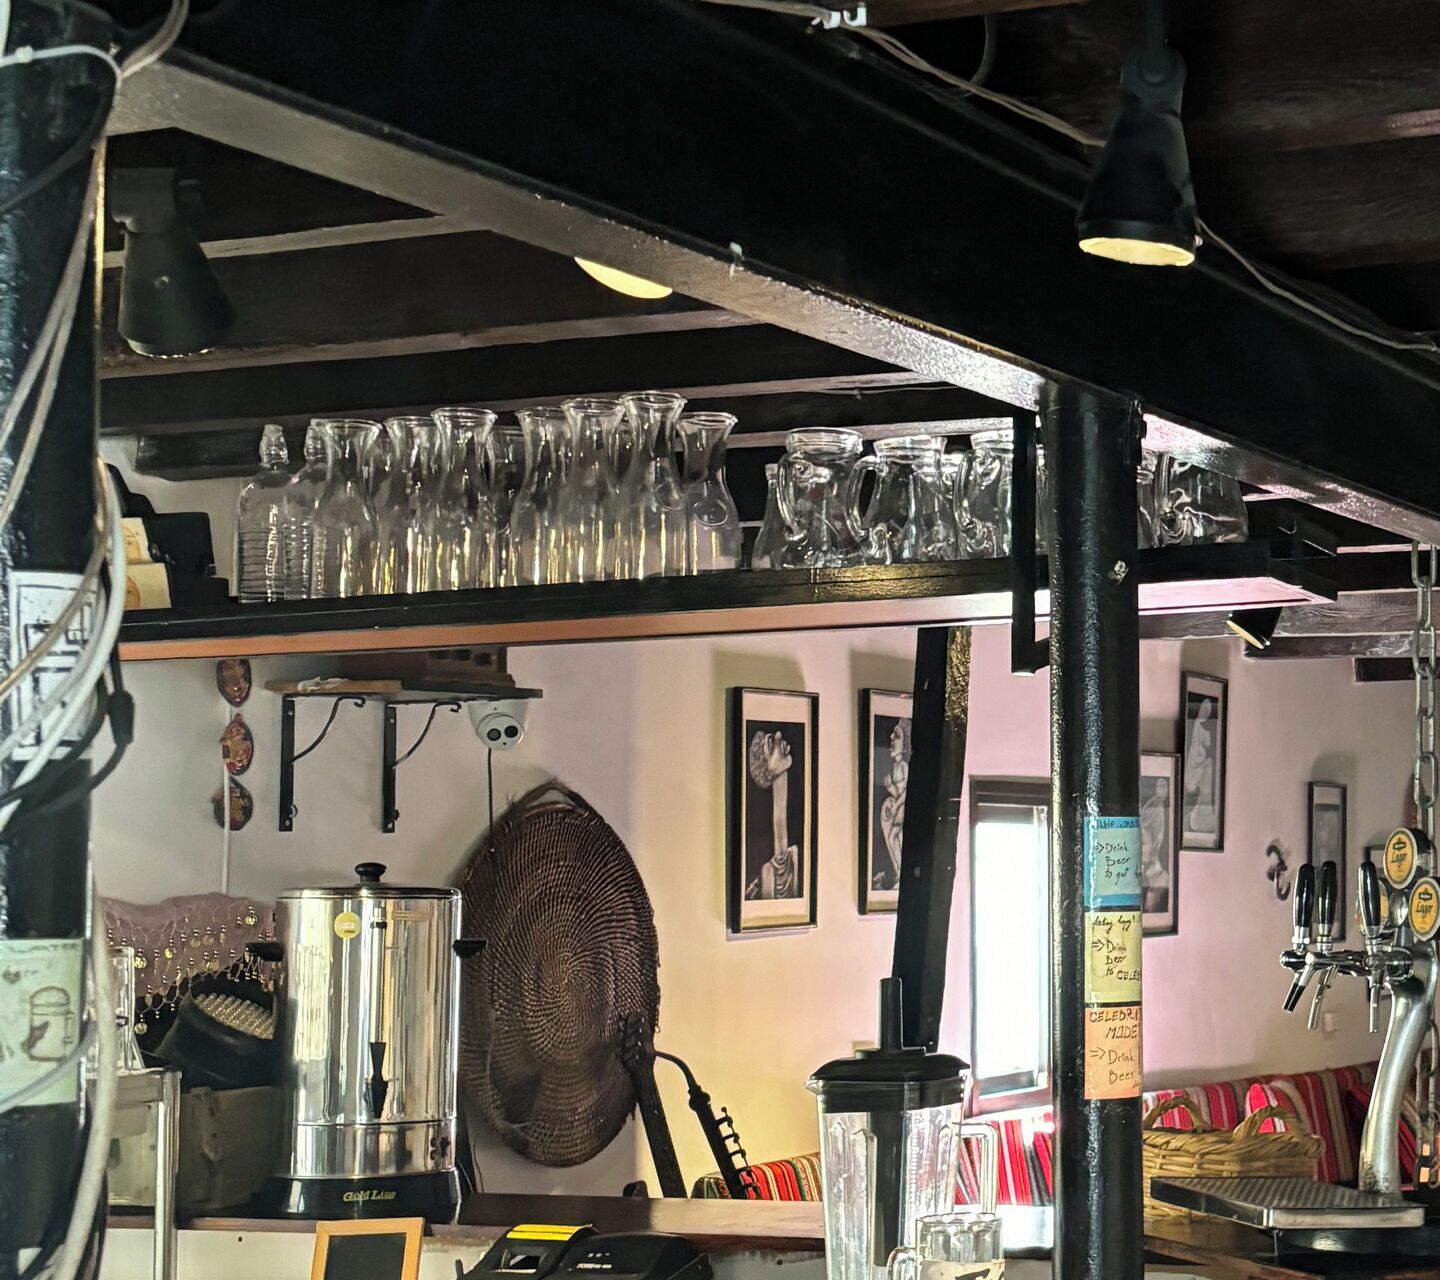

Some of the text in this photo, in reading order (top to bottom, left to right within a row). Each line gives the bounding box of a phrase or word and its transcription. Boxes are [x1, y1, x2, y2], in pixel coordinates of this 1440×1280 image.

[1105, 841, 1129, 854] Drink
[1105, 855, 1131, 868] Beer
[1415, 901, 1433, 920] Lager
[1106, 939, 1127, 954] Drink
[1105, 1024, 1138, 1040] MODE
[1108, 1048, 1136, 1065] Drink
[1108, 1069, 1135, 1085] Beer
[343, 1190, 370, 1202] Gold
